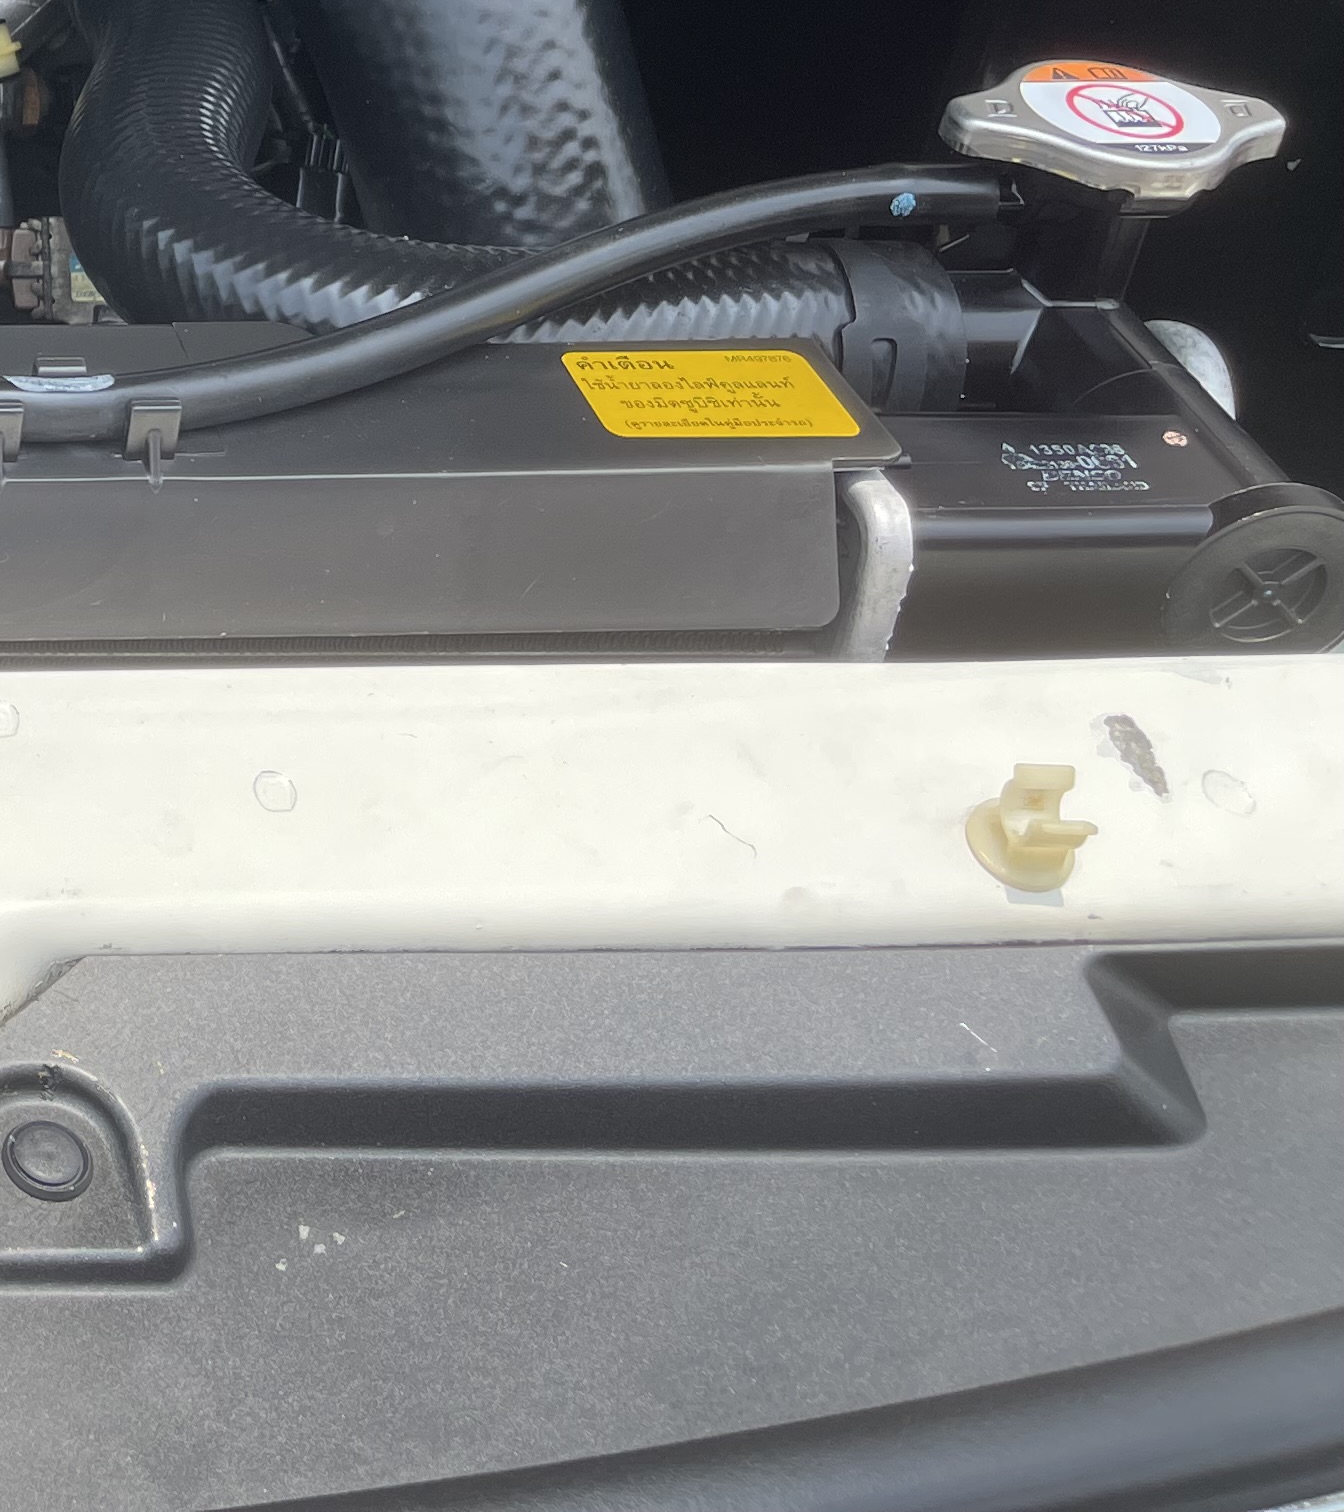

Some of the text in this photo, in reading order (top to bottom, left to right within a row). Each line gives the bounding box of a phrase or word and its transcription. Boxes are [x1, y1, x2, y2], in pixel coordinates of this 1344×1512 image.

[575, 355, 675, 371] คำเตือน
[1041, 470, 1122, 481] DENSO
